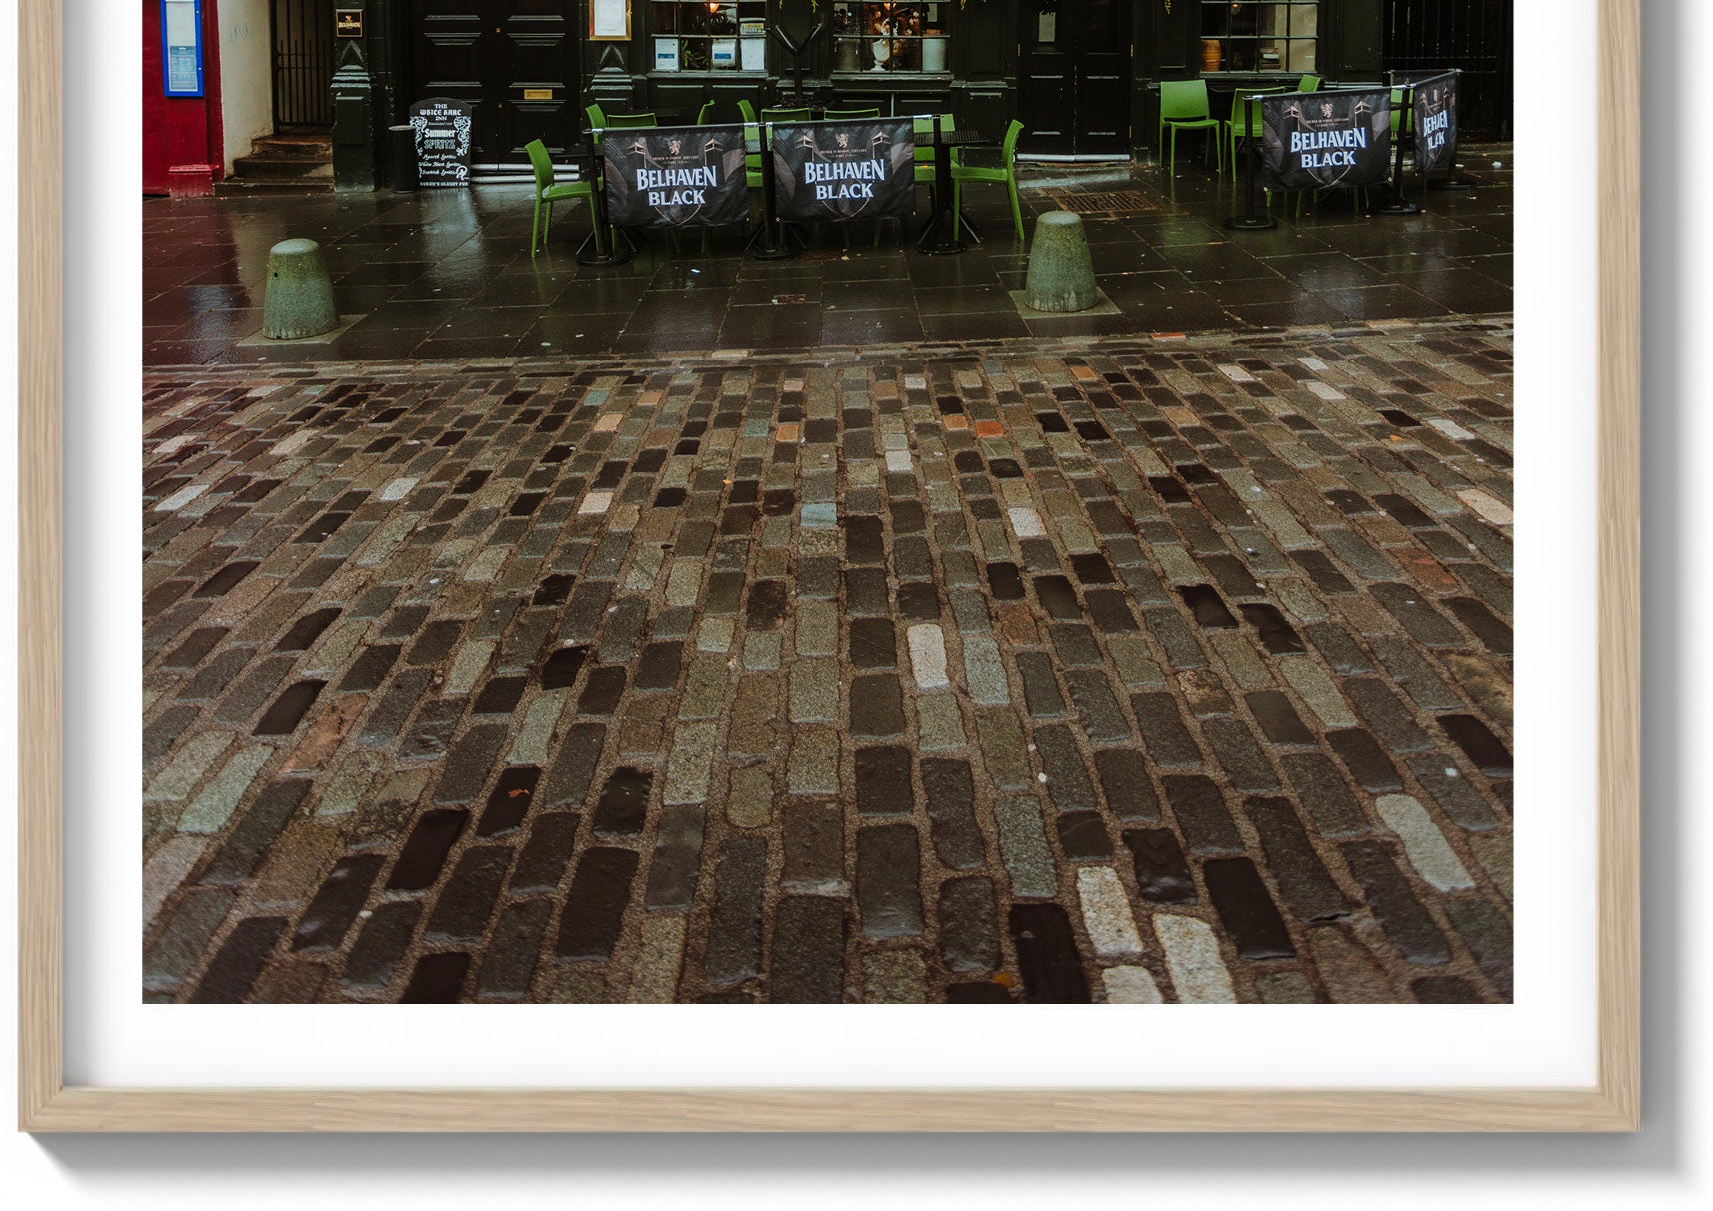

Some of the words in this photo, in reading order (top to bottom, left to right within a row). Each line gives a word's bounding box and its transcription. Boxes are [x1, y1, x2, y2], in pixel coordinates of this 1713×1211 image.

[424, 128, 455, 138] Summer
[1291, 127, 1366, 153] BELHAVEN
[1301, 150, 1356, 168] BLACK
[636, 165, 717, 191] BELHAVEN
[805, 159, 885, 184] BELHAVEN
[648, 189, 706, 206] BLACK
[816, 183, 874, 200] BLACK
